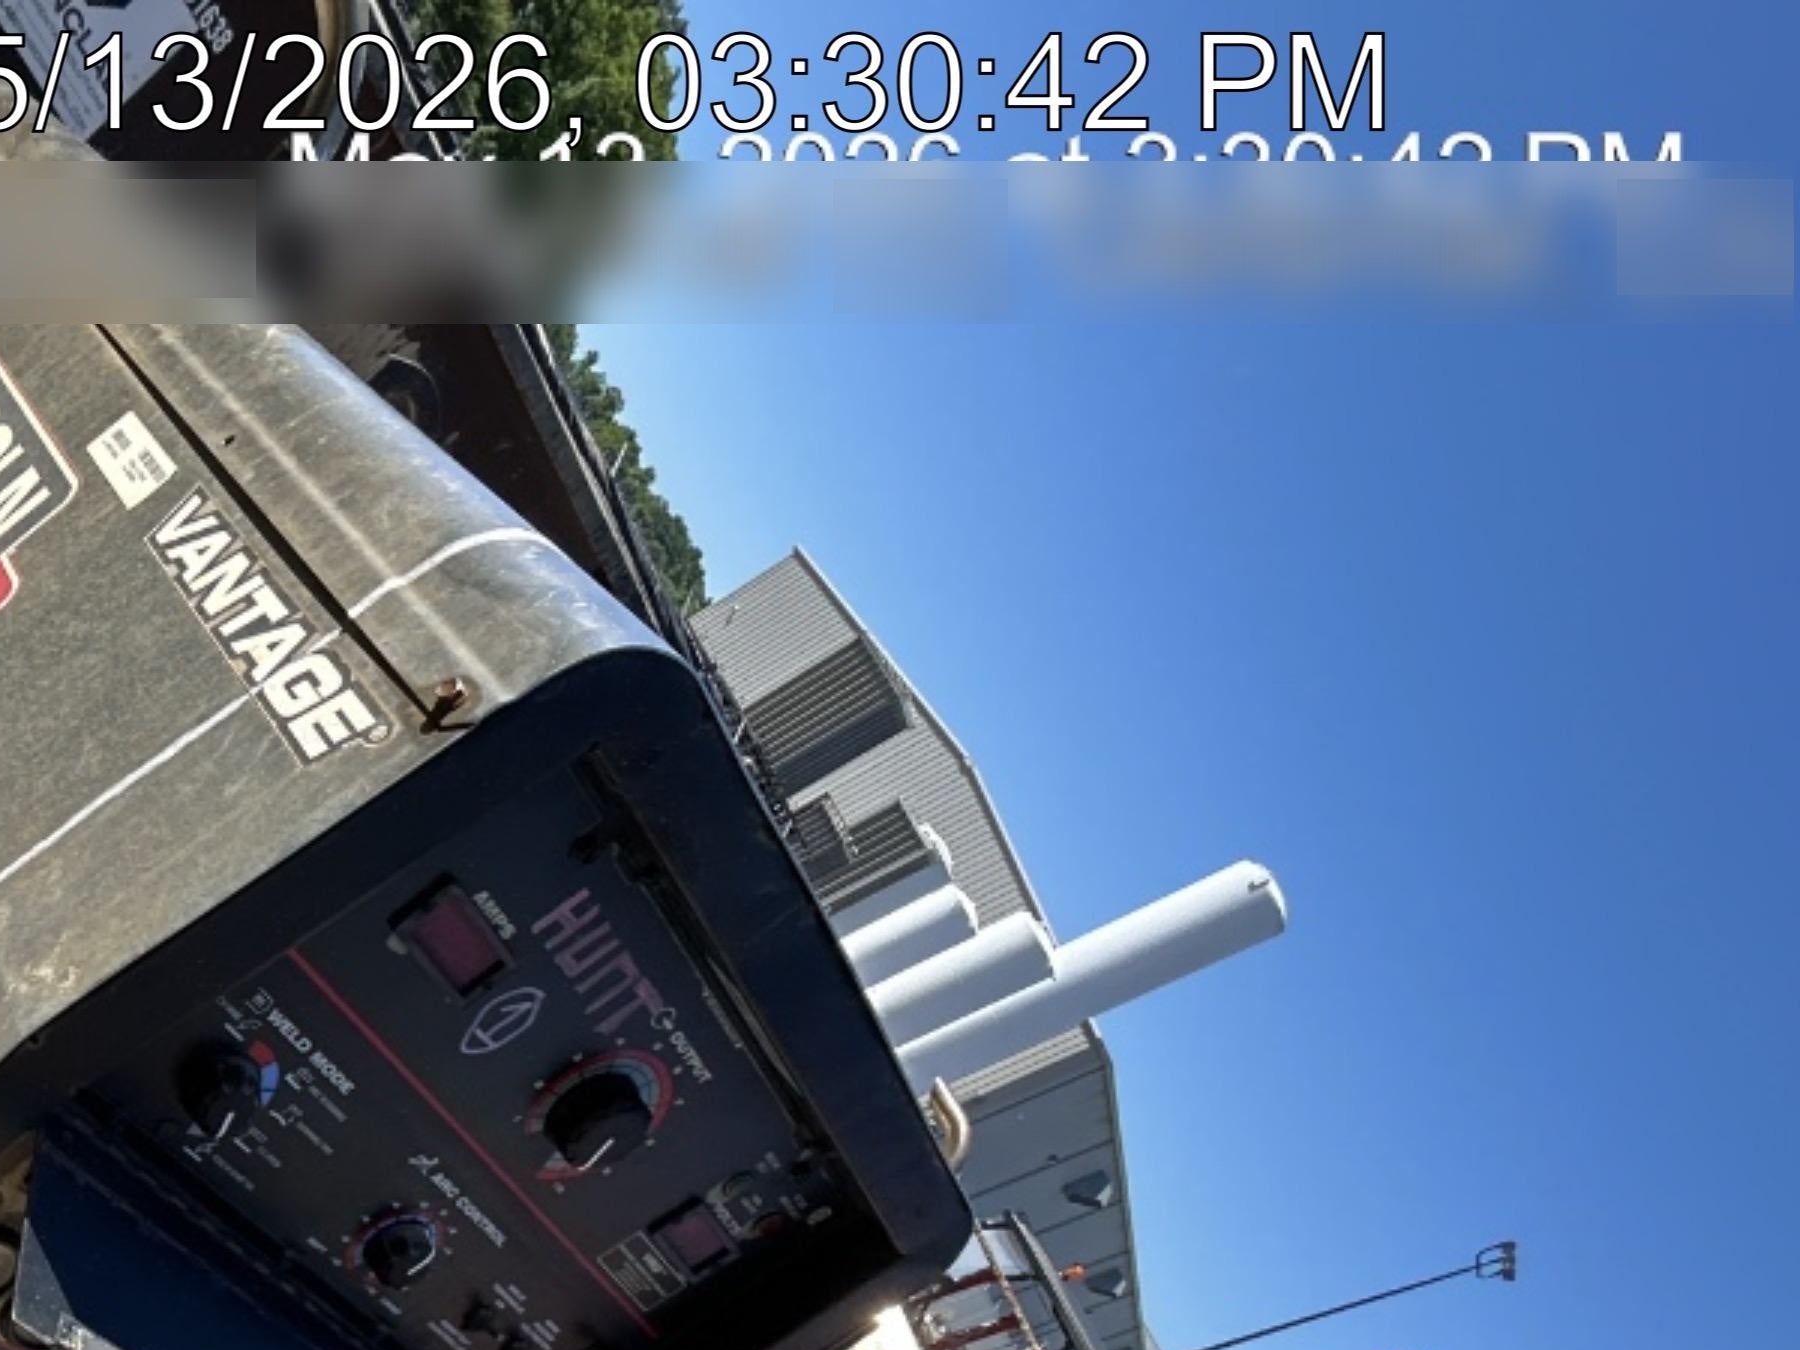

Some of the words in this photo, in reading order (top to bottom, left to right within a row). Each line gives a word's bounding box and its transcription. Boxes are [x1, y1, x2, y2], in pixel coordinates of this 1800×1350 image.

[186, 0, 237, 54] 1638
[152, 494, 371, 760] VANTAGE
[473, 890, 517, 939] AMPS
[267, 1007, 313, 1054] WELD
[311, 1048, 355, 1097] MODE
[668, 1027, 712, 1083] OUTPUT
[431, 1171, 464, 1202] ARC
[461, 1200, 506, 1248] CONTROL
